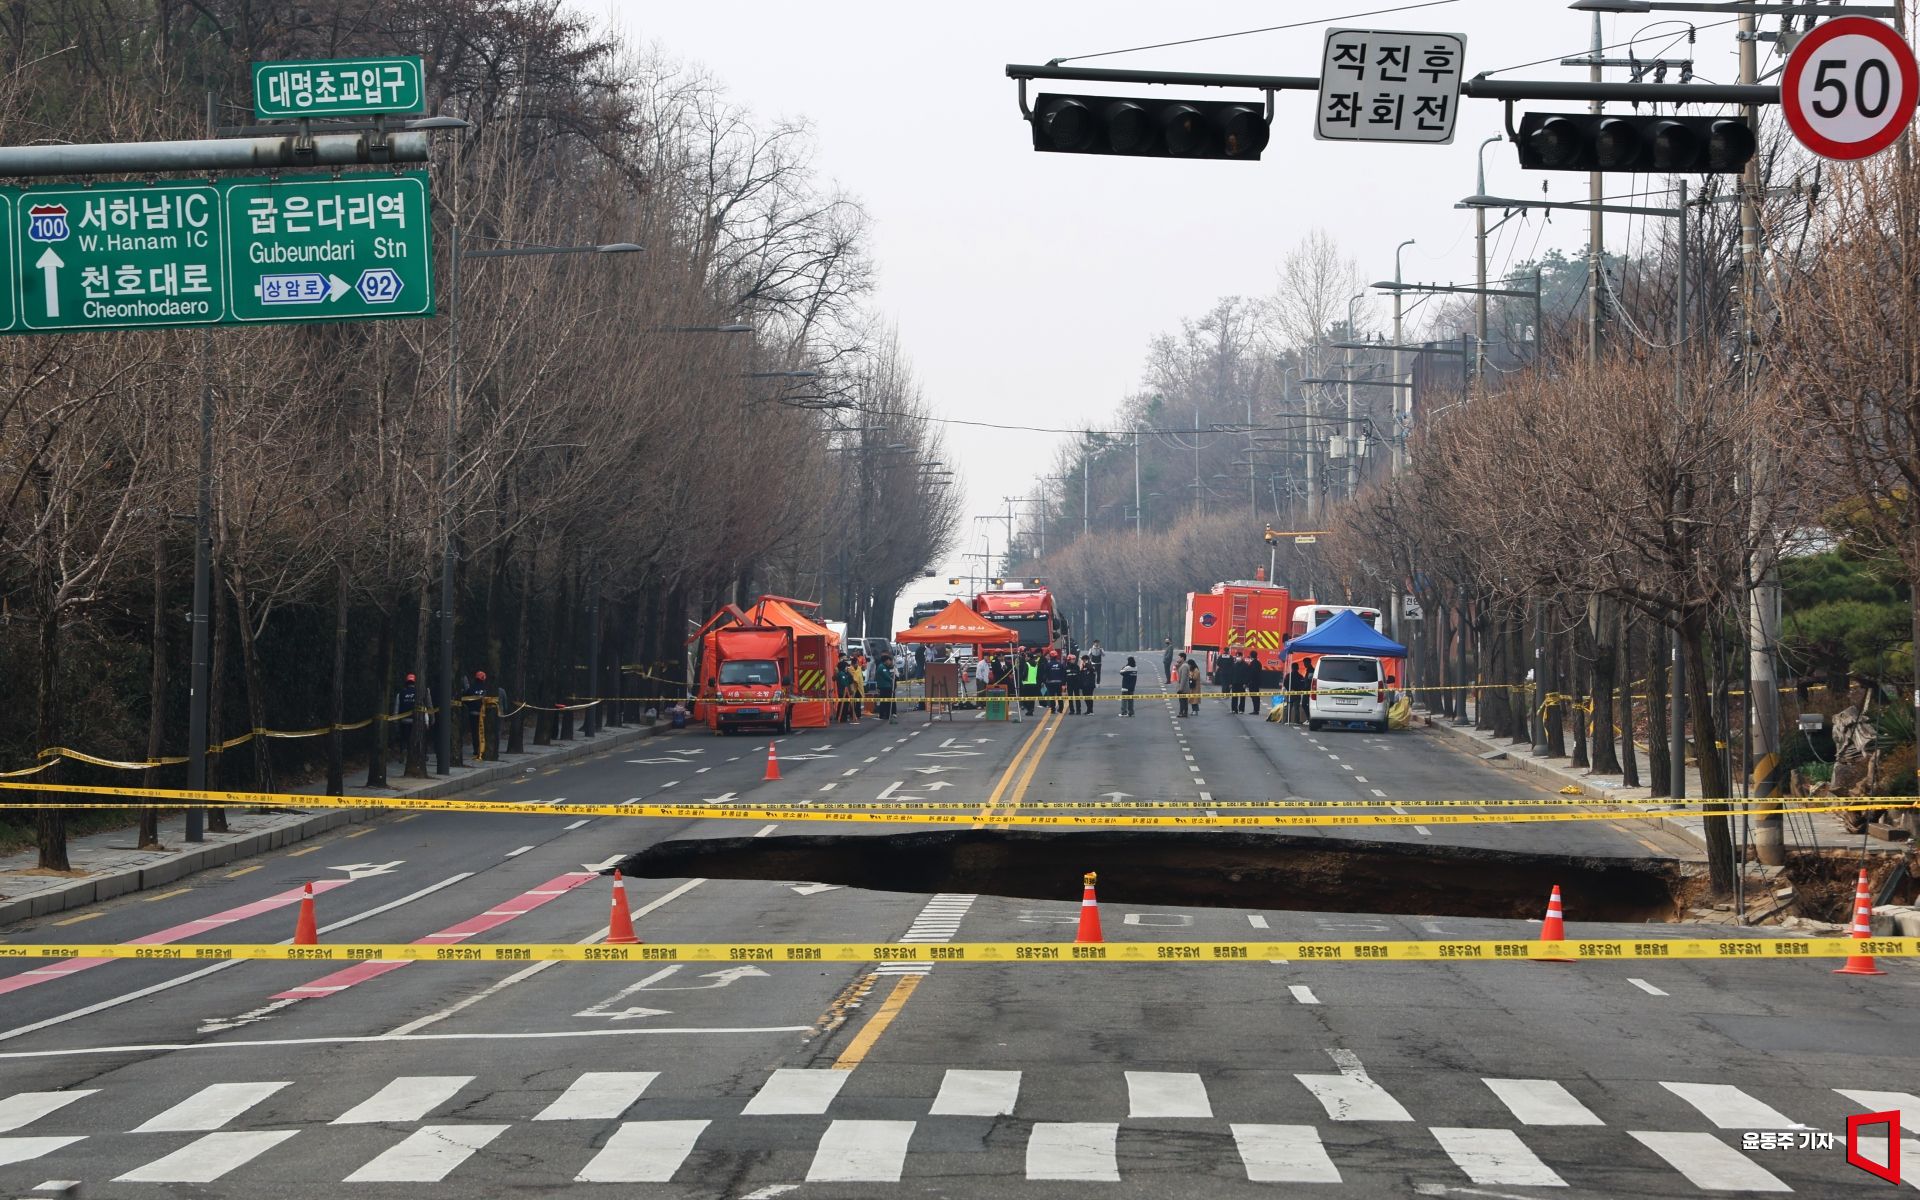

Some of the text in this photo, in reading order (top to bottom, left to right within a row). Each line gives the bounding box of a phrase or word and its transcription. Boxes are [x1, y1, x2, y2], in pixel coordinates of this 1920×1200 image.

[1332, 43, 1455, 83] 직진후
[268, 66, 405, 108] 대명초교입구
[1811, 58, 1890, 120] 50
[1325, 91, 1449, 132] 좌회전
[34, 216, 65, 238] 100
[77, 192, 209, 232] 서하남IC
[247, 191, 406, 235] 굽은다리역
[187, 230, 209, 248] IC
[249, 236, 407, 264] Gubeundari Stn
[80, 263, 213, 299] 천호대로
[265, 274, 321, 298] 상암로
[365, 274, 393, 298] 92
[83, 299, 209, 320] Cheonhodaero
[728, 690, 770, 698] 서울 소방
